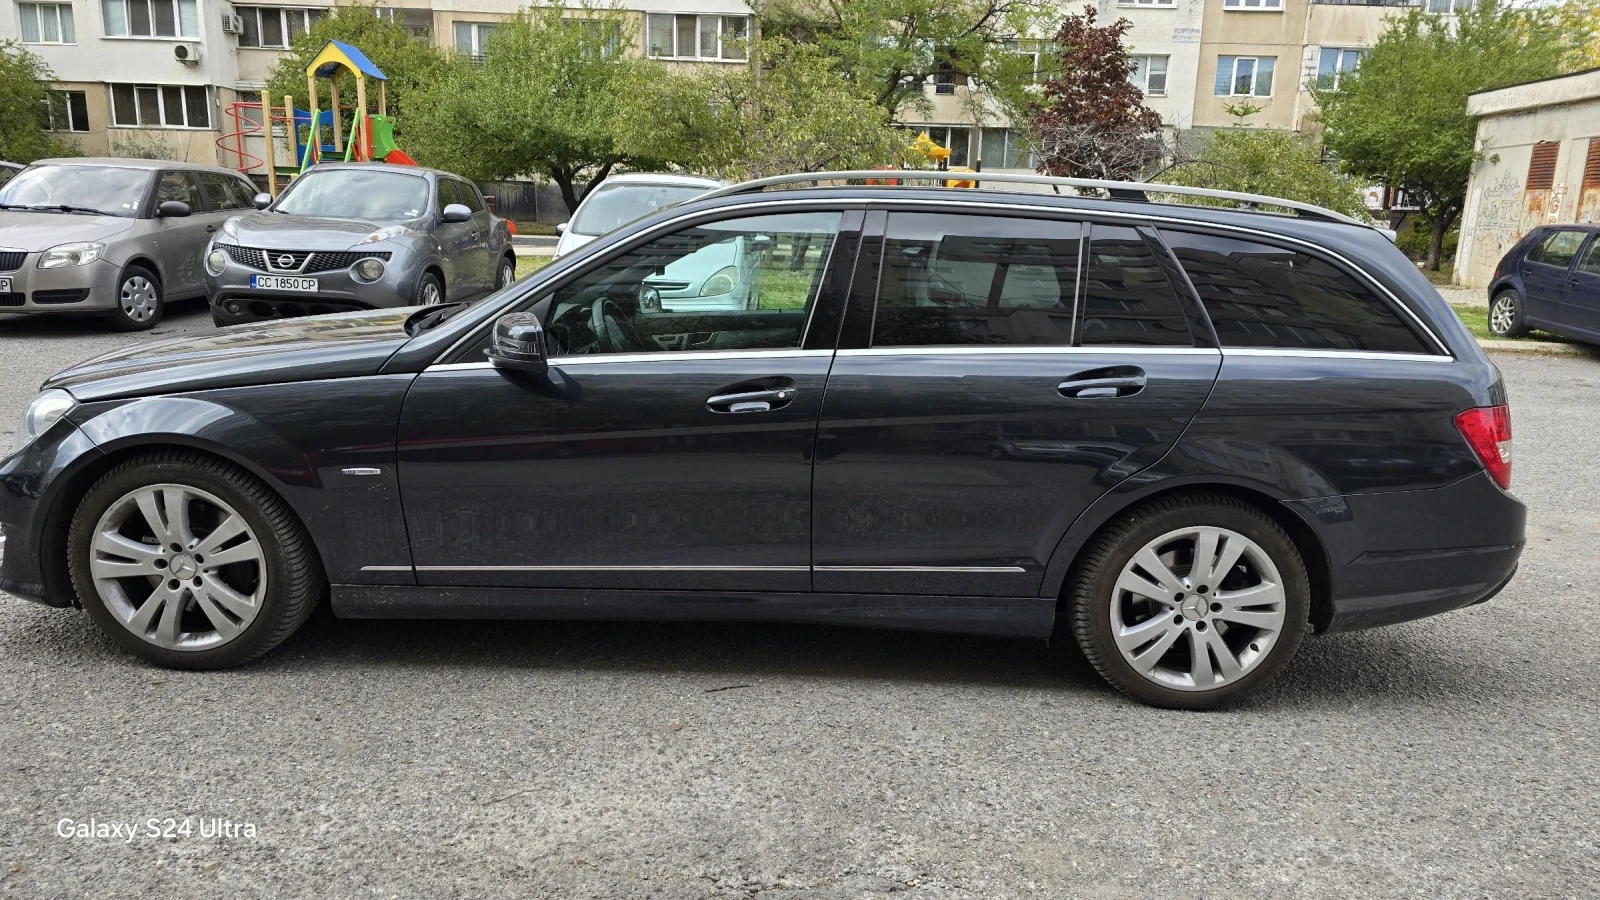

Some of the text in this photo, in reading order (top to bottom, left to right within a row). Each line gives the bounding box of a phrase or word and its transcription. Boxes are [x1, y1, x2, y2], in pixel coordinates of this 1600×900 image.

[258, 277, 271, 287] CC
[275, 278, 299, 288] 1850
[301, 279, 315, 290] CP
